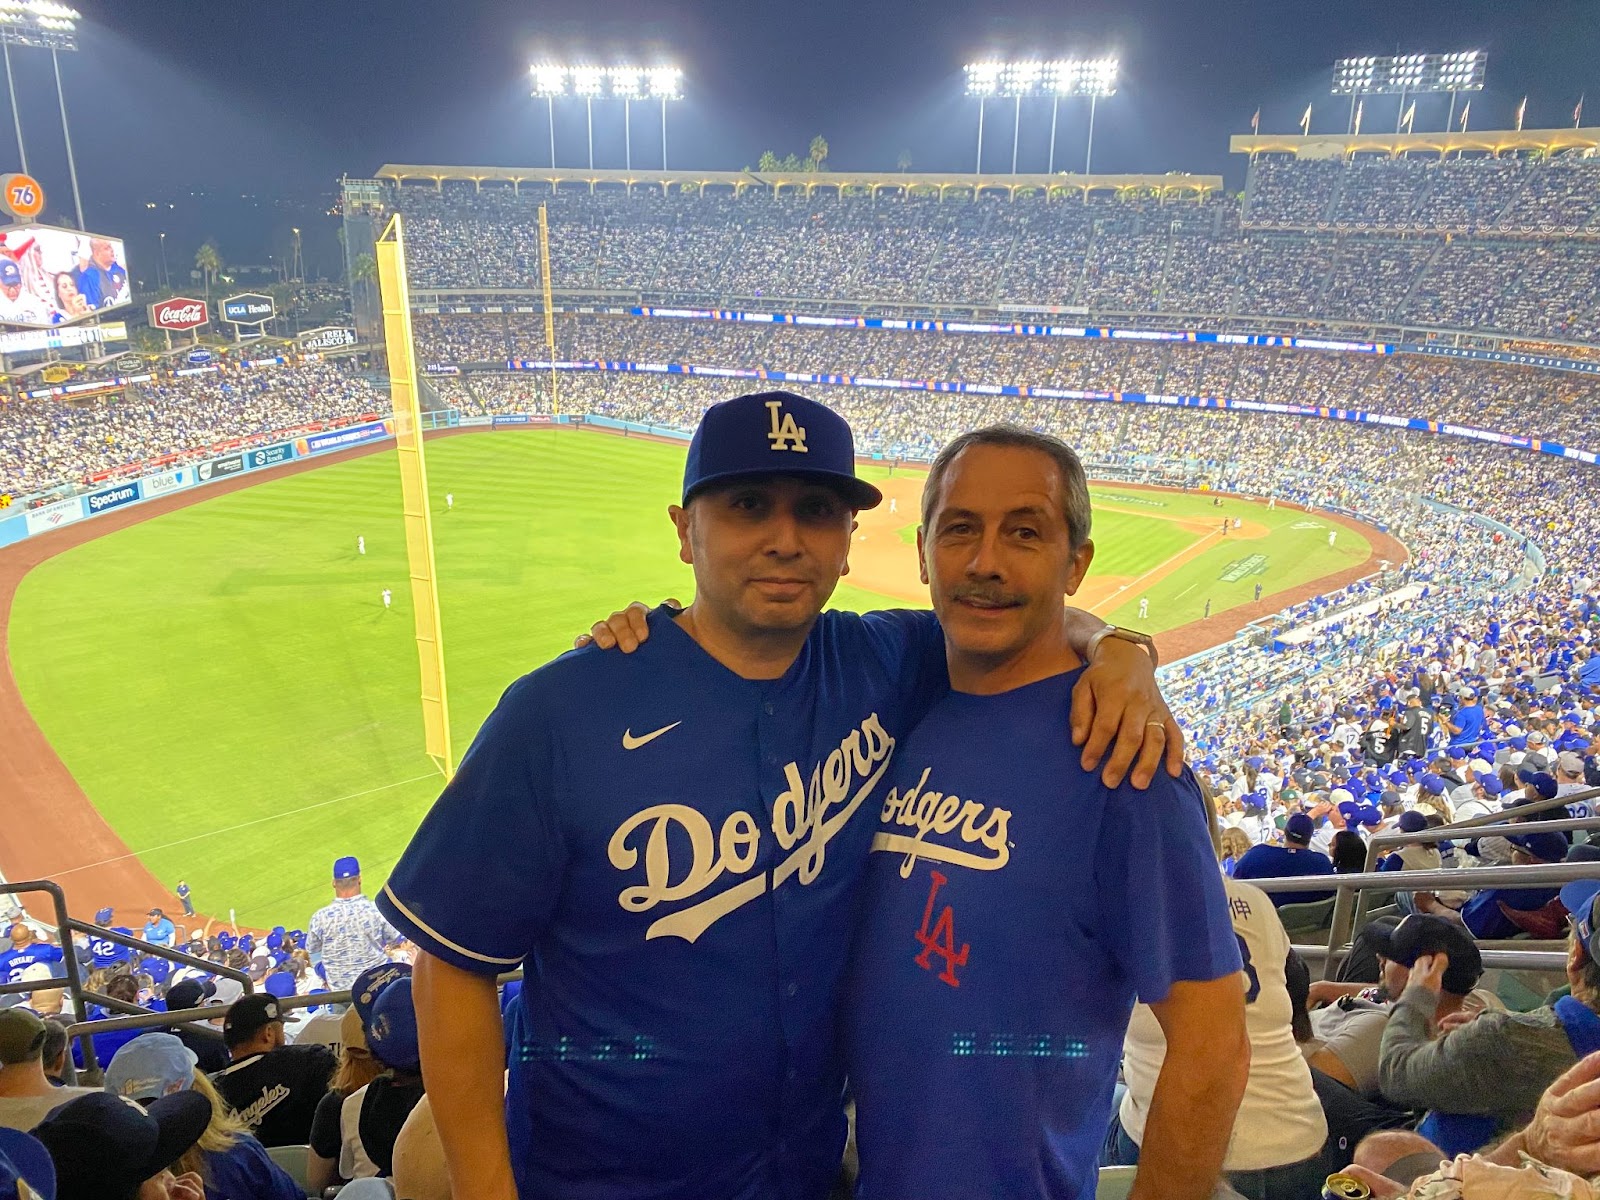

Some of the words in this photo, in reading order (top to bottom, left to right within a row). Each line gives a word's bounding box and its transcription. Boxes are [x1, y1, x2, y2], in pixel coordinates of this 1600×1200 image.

[11, 185, 34, 206] 76
[228, 305, 246, 315] UCLA
[247, 303, 271, 314] Health
[1417, 346, 1477, 357] WELCOME
[1486, 352, 1501, 360] TO
[1510, 355, 1561, 366] DODGER
[765, 401, 808, 453] LA
[152, 474, 174, 489] blue
[90, 487, 133, 509] Spectrum
[31, 510, 46, 519] BANK
[1421, 717, 1429, 735] 5
[1346, 734, 1356, 745] 17
[1374, 738, 1387, 754] 5
[608, 712, 895, 914] Dodgers
[880, 767, 1012, 879] odgers
[914, 870, 970, 987] LA
[92, 941, 115, 957] 42
[8, 955, 35, 968] BRYANT
[229, 1083, 290, 1125] Angeles
